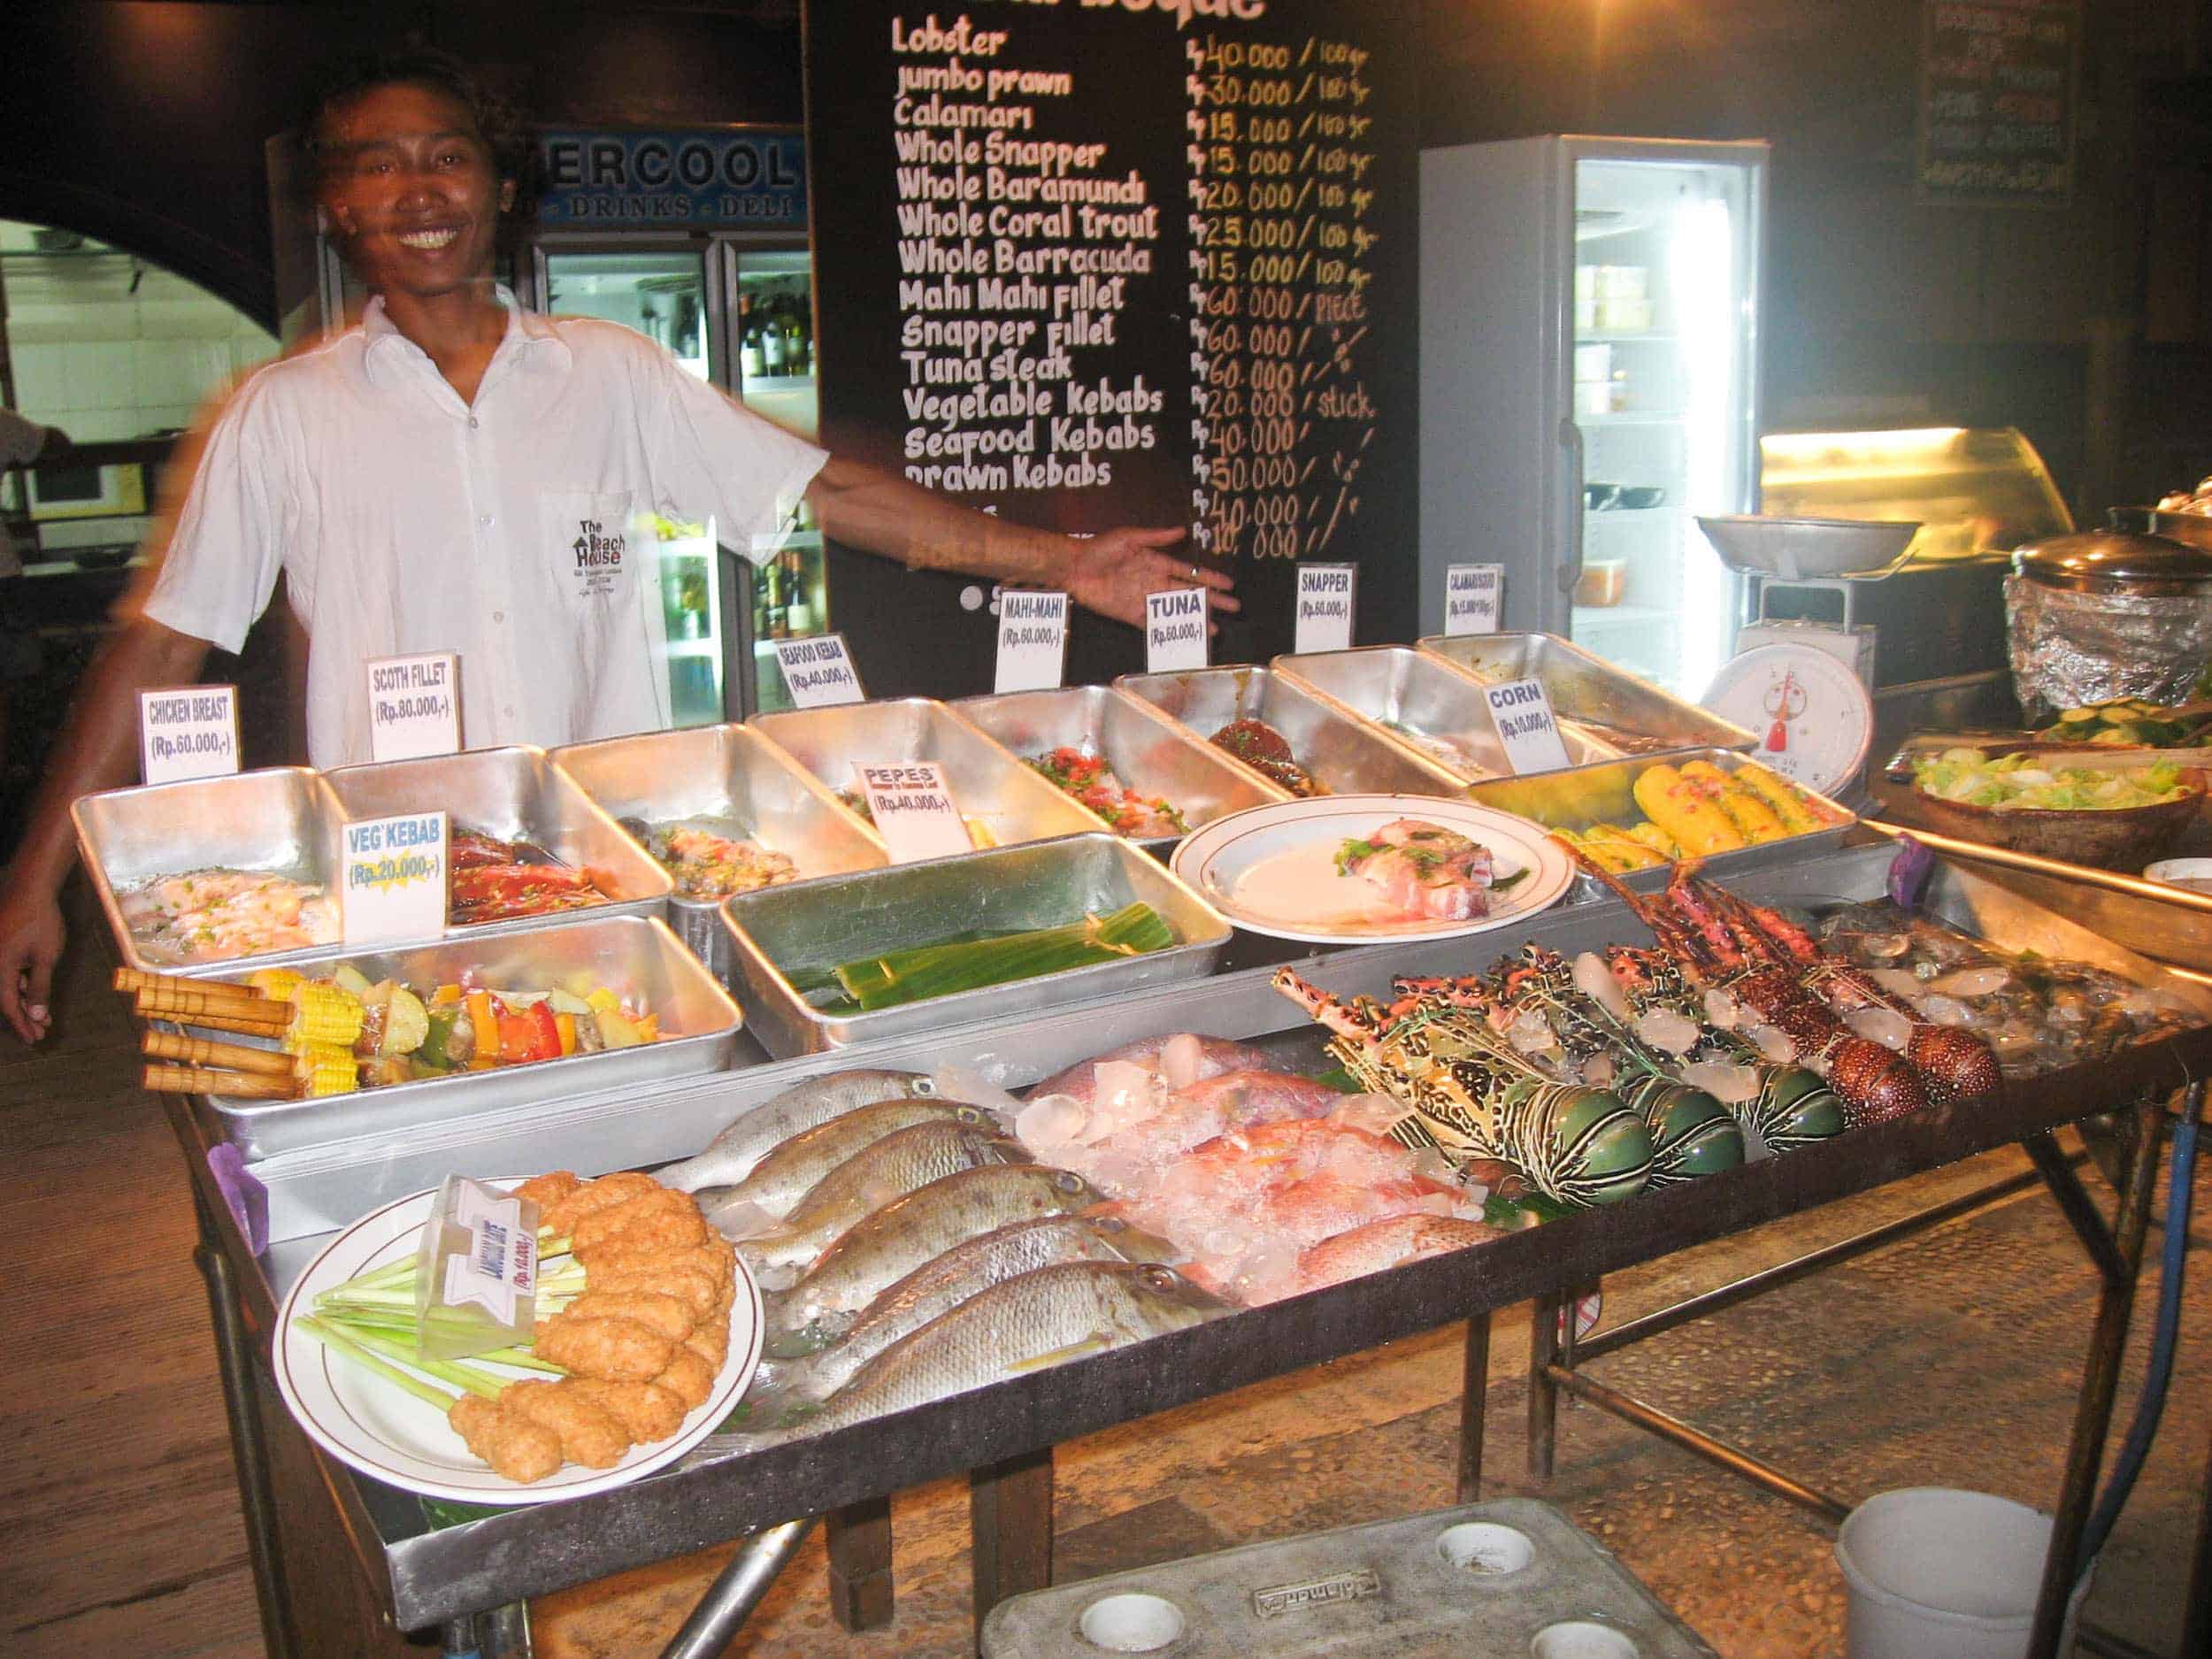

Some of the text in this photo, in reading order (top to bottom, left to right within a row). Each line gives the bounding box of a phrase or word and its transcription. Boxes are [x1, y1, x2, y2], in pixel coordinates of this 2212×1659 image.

[892, 13, 1009, 56] Lobster
[894, 56, 984, 99] jumbo
[987, 69, 1073, 102] prawn
[894, 93, 1034, 130] Calamari
[894, 129, 983, 165] Whole
[985, 130, 1108, 176] Snapper
[896, 165, 983, 200] Whole
[987, 165, 1147, 204] Baramundi
[571, 195, 692, 218] DRINKS
[897, 201, 984, 237] Whole
[988, 203, 1071, 238] Coral
[898, 237, 989, 273] Whole
[994, 238, 1152, 273] Barracuda
[899, 273, 972, 310] Mahi
[977, 274, 1048, 310] Mahi
[901, 314, 1037, 358] Snapper
[901, 349, 983, 384] Tuna
[902, 381, 1053, 432] Vegetable
[1067, 374, 1164, 415] Kebabs
[1050, 414, 1156, 452] Kebabs
[1012, 451, 1111, 489] Kebabs
[580, 519, 603, 534] The
[575, 548, 621, 567] House
[1302, 573, 1348, 593] SNAPPER
[1005, 596, 1064, 618] MAHI-MAHI
[1150, 594, 1202, 618] TUNA
[373, 662, 447, 692] SCOTH FILLET
[149, 695, 228, 725] CHICKEN BREAST
[1489, 682, 1541, 708] CORN
[864, 767, 934, 783] PEPES
[386, 818, 440, 848] KEBAB
